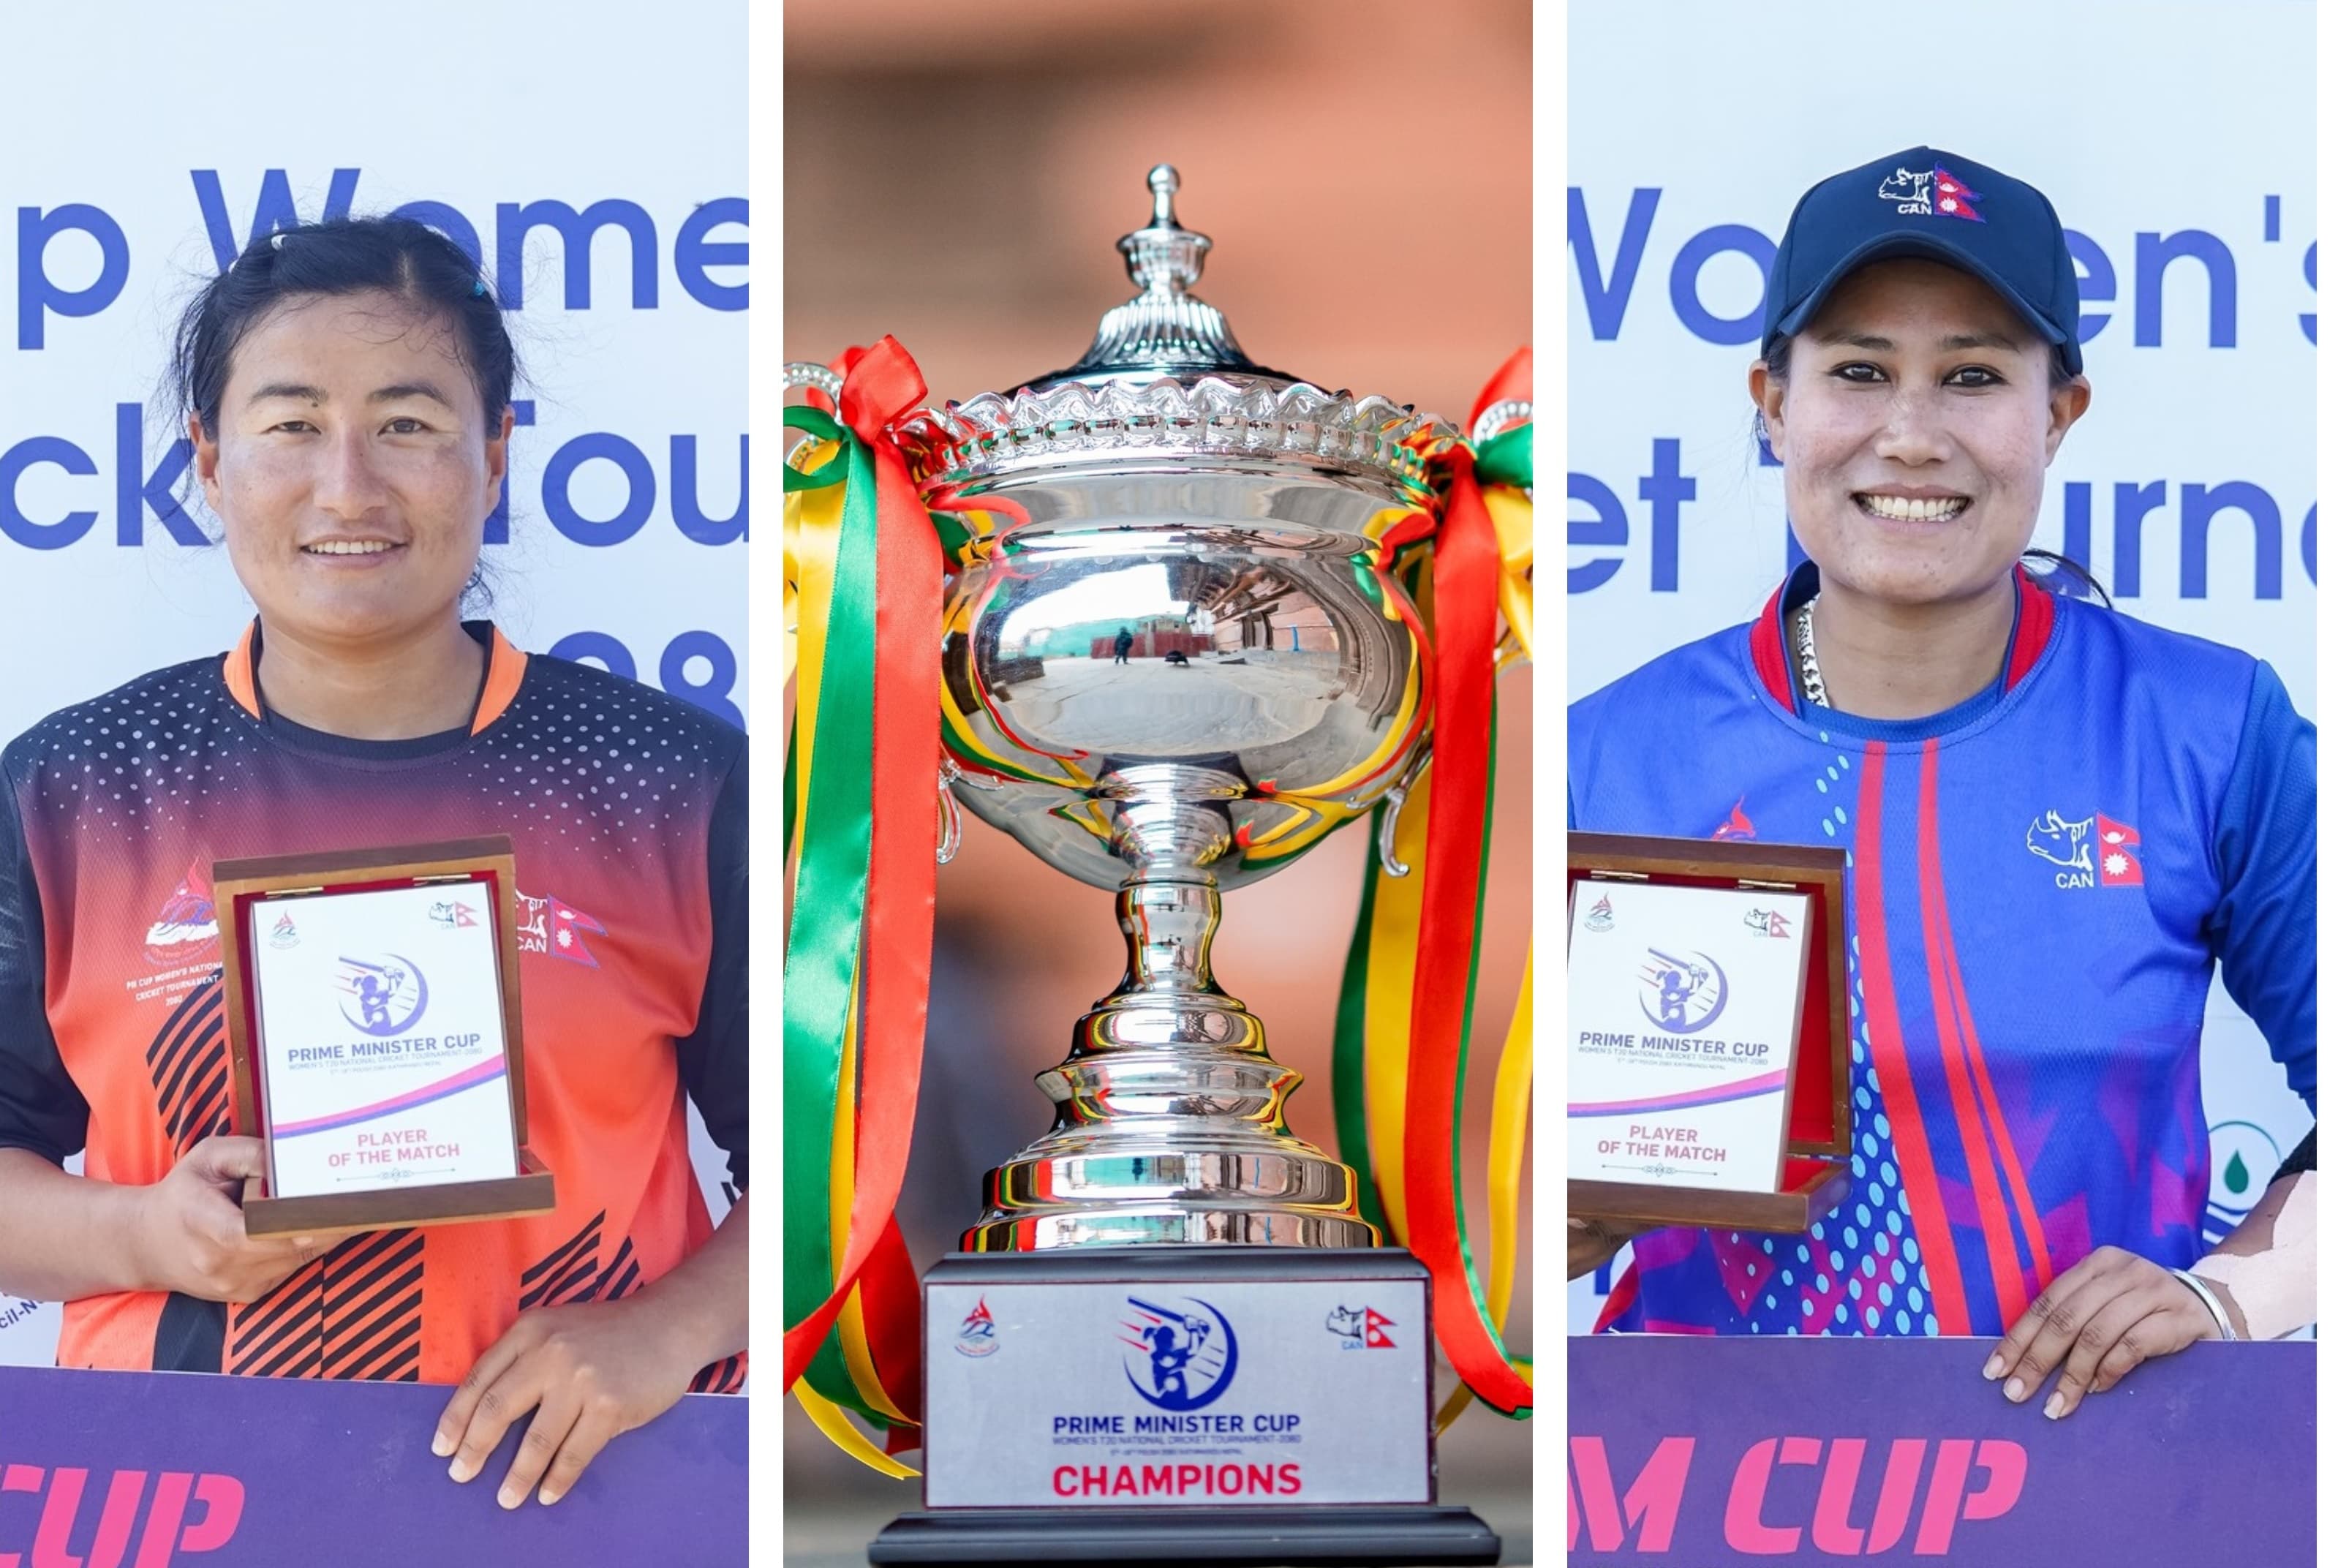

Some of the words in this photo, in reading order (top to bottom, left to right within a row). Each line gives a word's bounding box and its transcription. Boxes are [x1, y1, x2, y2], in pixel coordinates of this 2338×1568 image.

[1898, 203, 1932, 215] CAN
[2055, 872, 2094, 889] CAN
[189, 961, 223, 973] NATIONA
[287, 1044, 344, 1063] PRIME
[351, 1037, 437, 1058] MINISTER
[444, 1033, 481, 1049] CUP
[1579, 1031, 1635, 1049] PRIME
[1641, 1036, 1726, 1055] MINISTER
[1732, 1041, 1769, 1057] CUP
[358, 1128, 428, 1147] PLAYER
[1629, 1126, 1698, 1142] PLAYER
[328, 1153, 351, 1167] OF
[357, 1149, 392, 1165] THE
[397, 1144, 461, 1161] MATCH
[1598, 1140, 1621, 1154] OF
[1626, 1142, 1660, 1158] THE
[1664, 1145, 1727, 1161] MATCH
[1054, 1416, 1125, 1433] PRIME
[1135, 1415, 1244, 1433] MINISTER
[1253, 1414, 1300, 1432] CUP
[1053, 1463, 1302, 1496] CHAMPIONS
[1724, 1436, 2028, 1556] CUP
